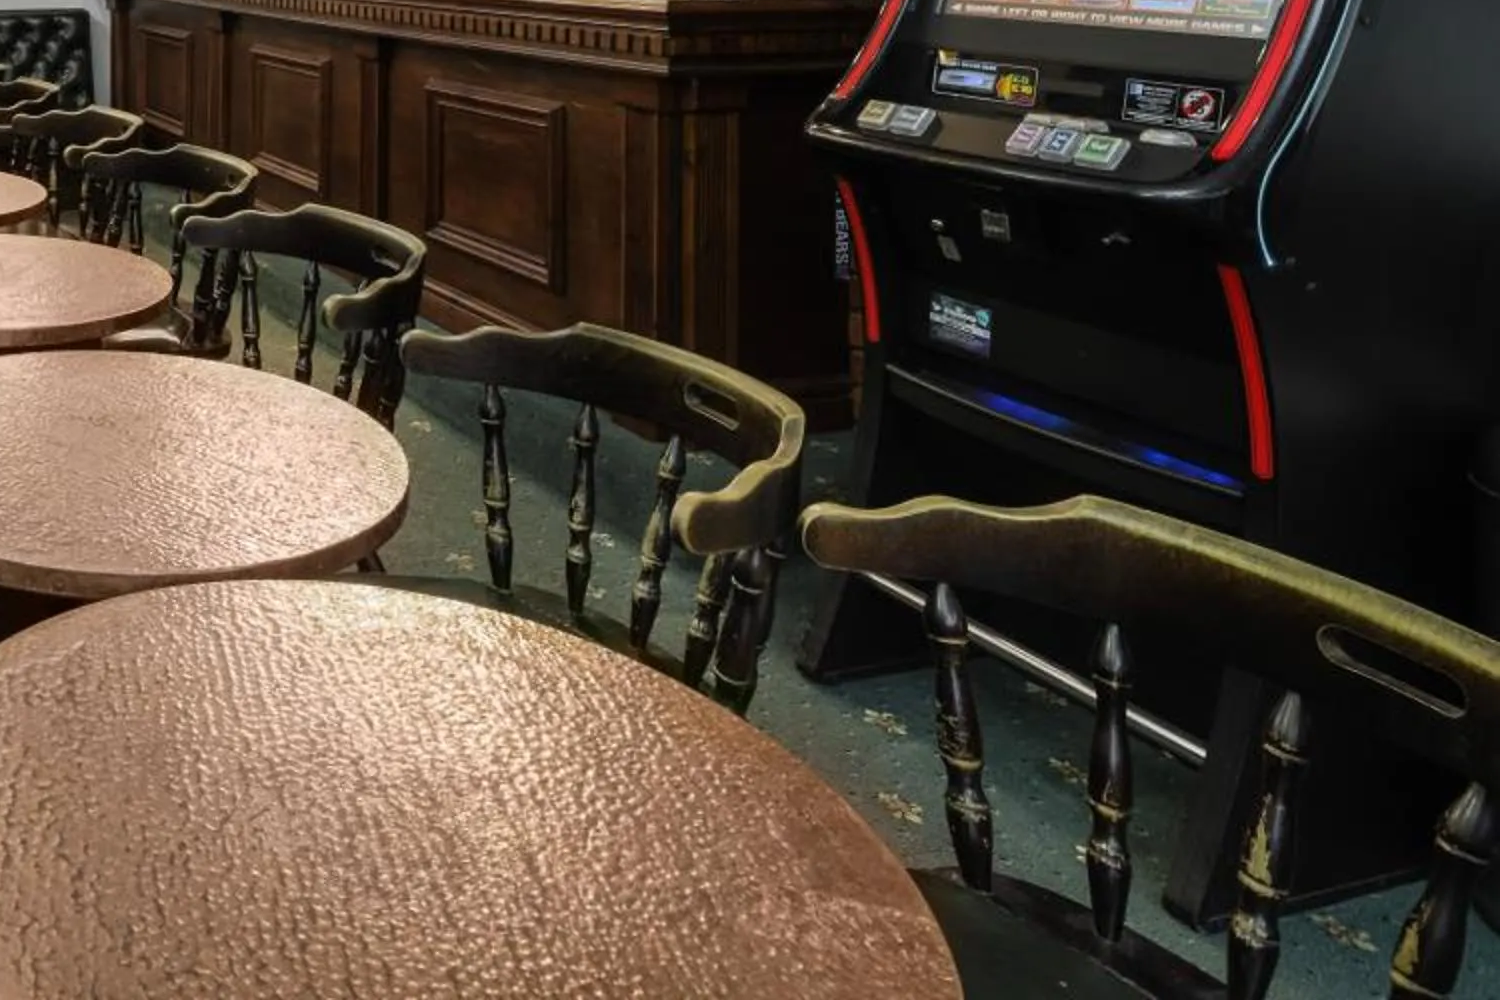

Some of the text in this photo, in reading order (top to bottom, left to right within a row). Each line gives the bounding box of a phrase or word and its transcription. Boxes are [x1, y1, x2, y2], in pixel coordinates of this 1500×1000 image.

[1002, 6, 1028, 17] LEFT
[1031, 9, 1048, 19] OR
[1091, 12, 1106, 23] TO
[1109, 14, 1146, 25] VIEW
[1146, 17, 1188, 28] MORE
